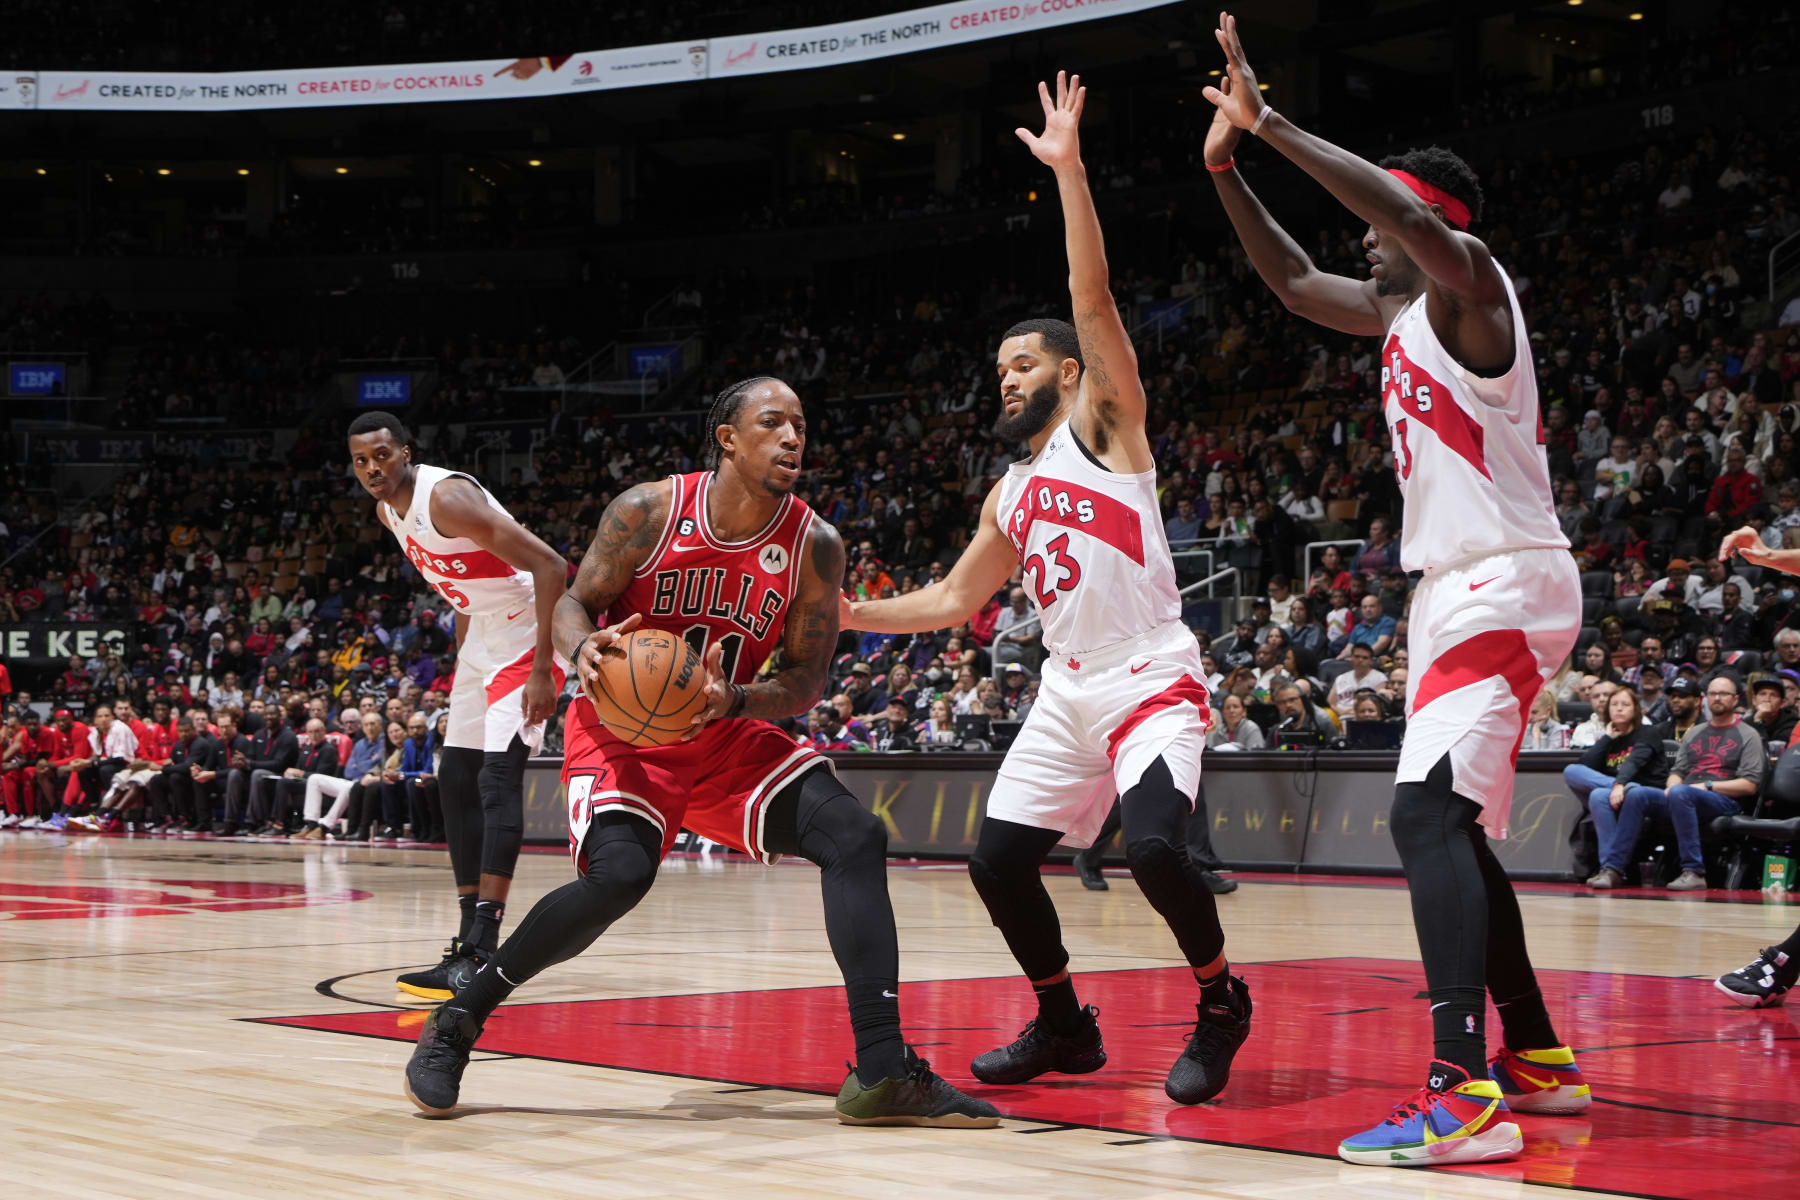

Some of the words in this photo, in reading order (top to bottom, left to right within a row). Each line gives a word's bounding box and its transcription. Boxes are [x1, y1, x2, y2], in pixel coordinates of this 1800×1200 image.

[950, 6, 1021, 30] CREATED
[766, 38, 839, 58] CREATED
[860, 31, 888, 46] THE
[891, 21, 941, 40] NORTH
[98, 84, 176, 98] CREATED
[178, 86, 197, 100] for
[199, 86, 230, 98] THE
[234, 84, 288, 98] NORTH
[297, 79, 372, 94] CREATED
[373, 79, 392, 94] for
[393, 74, 485, 91] COCKTAILS
[1641, 105, 1674, 128] 118
[392, 263, 420, 279] 116
[18, 371, 56, 387] IBM
[364, 381, 402, 399] IBM
[680, 519, 694, 535] 6
[1024, 532, 1081, 610] 23
[651, 567, 785, 642] BULLS
[47, 629, 126, 658] KEG
[682, 623, 746, 685] 11
[1213, 807, 1389, 835] EWELLE
